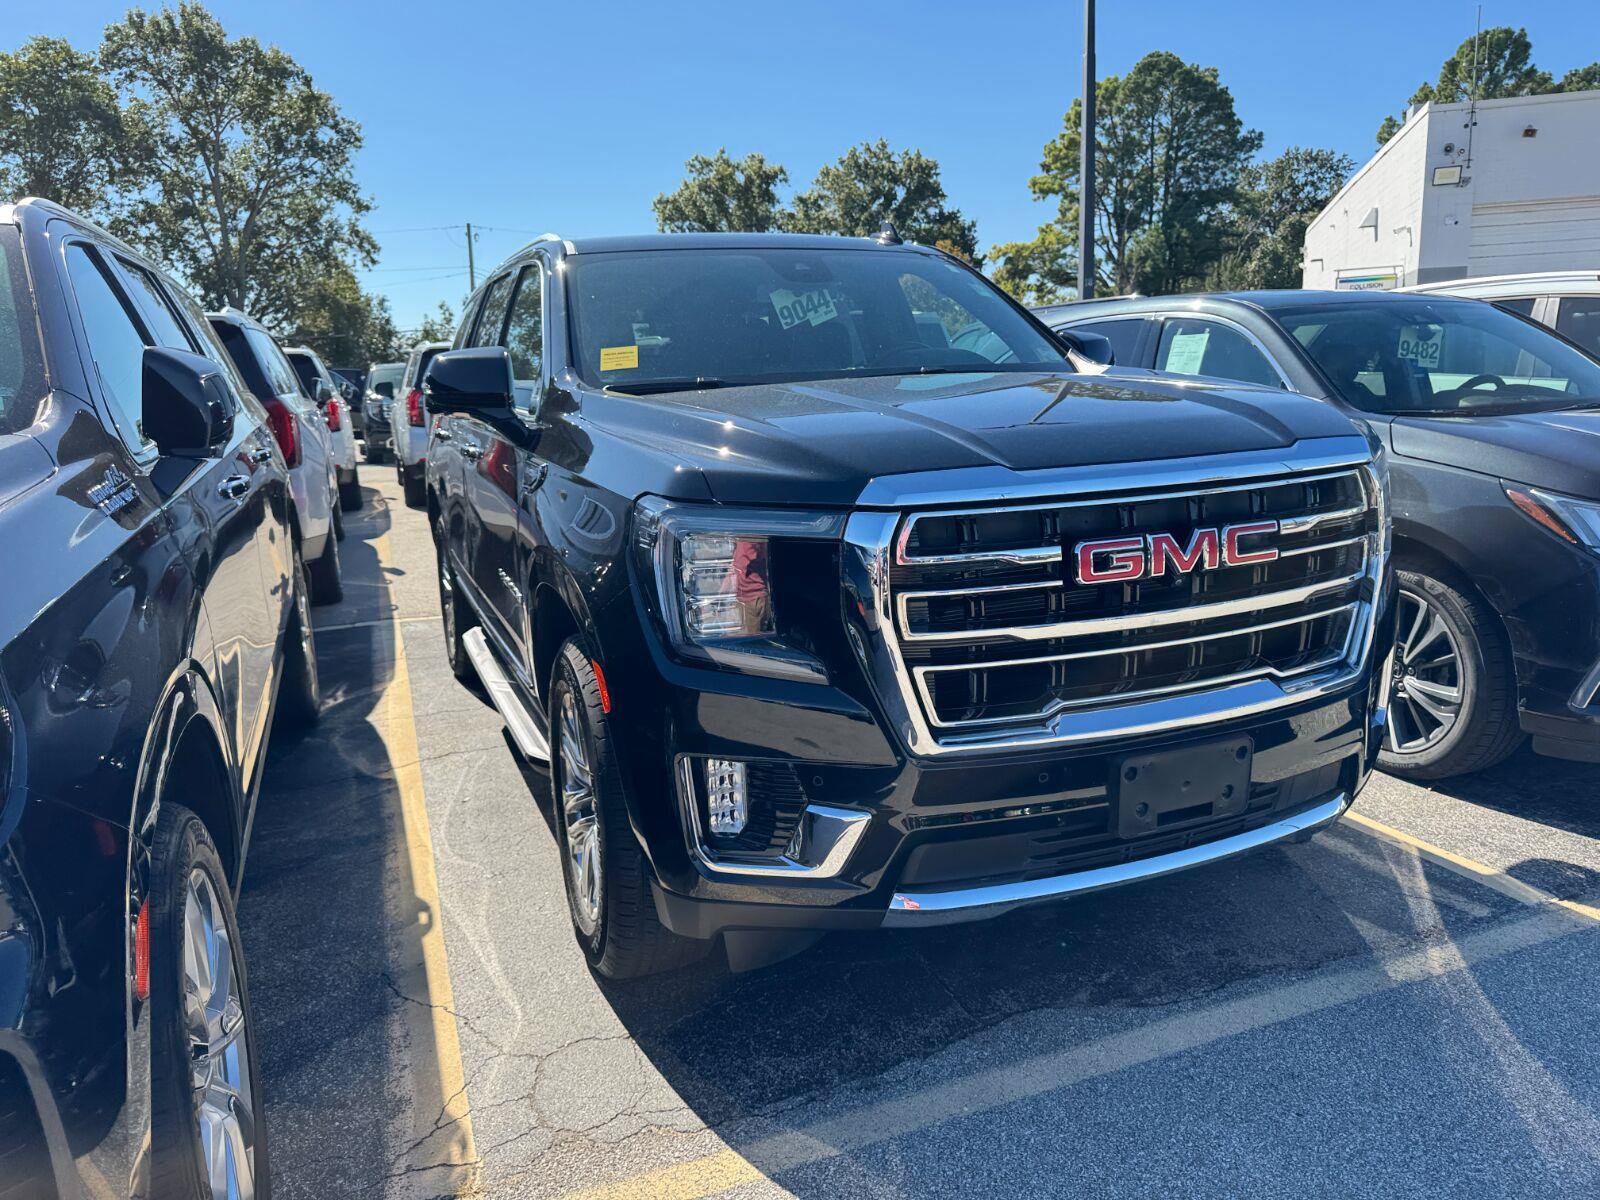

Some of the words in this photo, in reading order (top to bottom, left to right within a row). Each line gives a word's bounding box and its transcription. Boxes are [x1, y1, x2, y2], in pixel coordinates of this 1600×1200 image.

[1349, 282, 1384, 290] COLLISION
[779, 287, 832, 327] 9044
[1400, 340, 1439, 360] 9482
[1074, 520, 1279, 585] GMC
